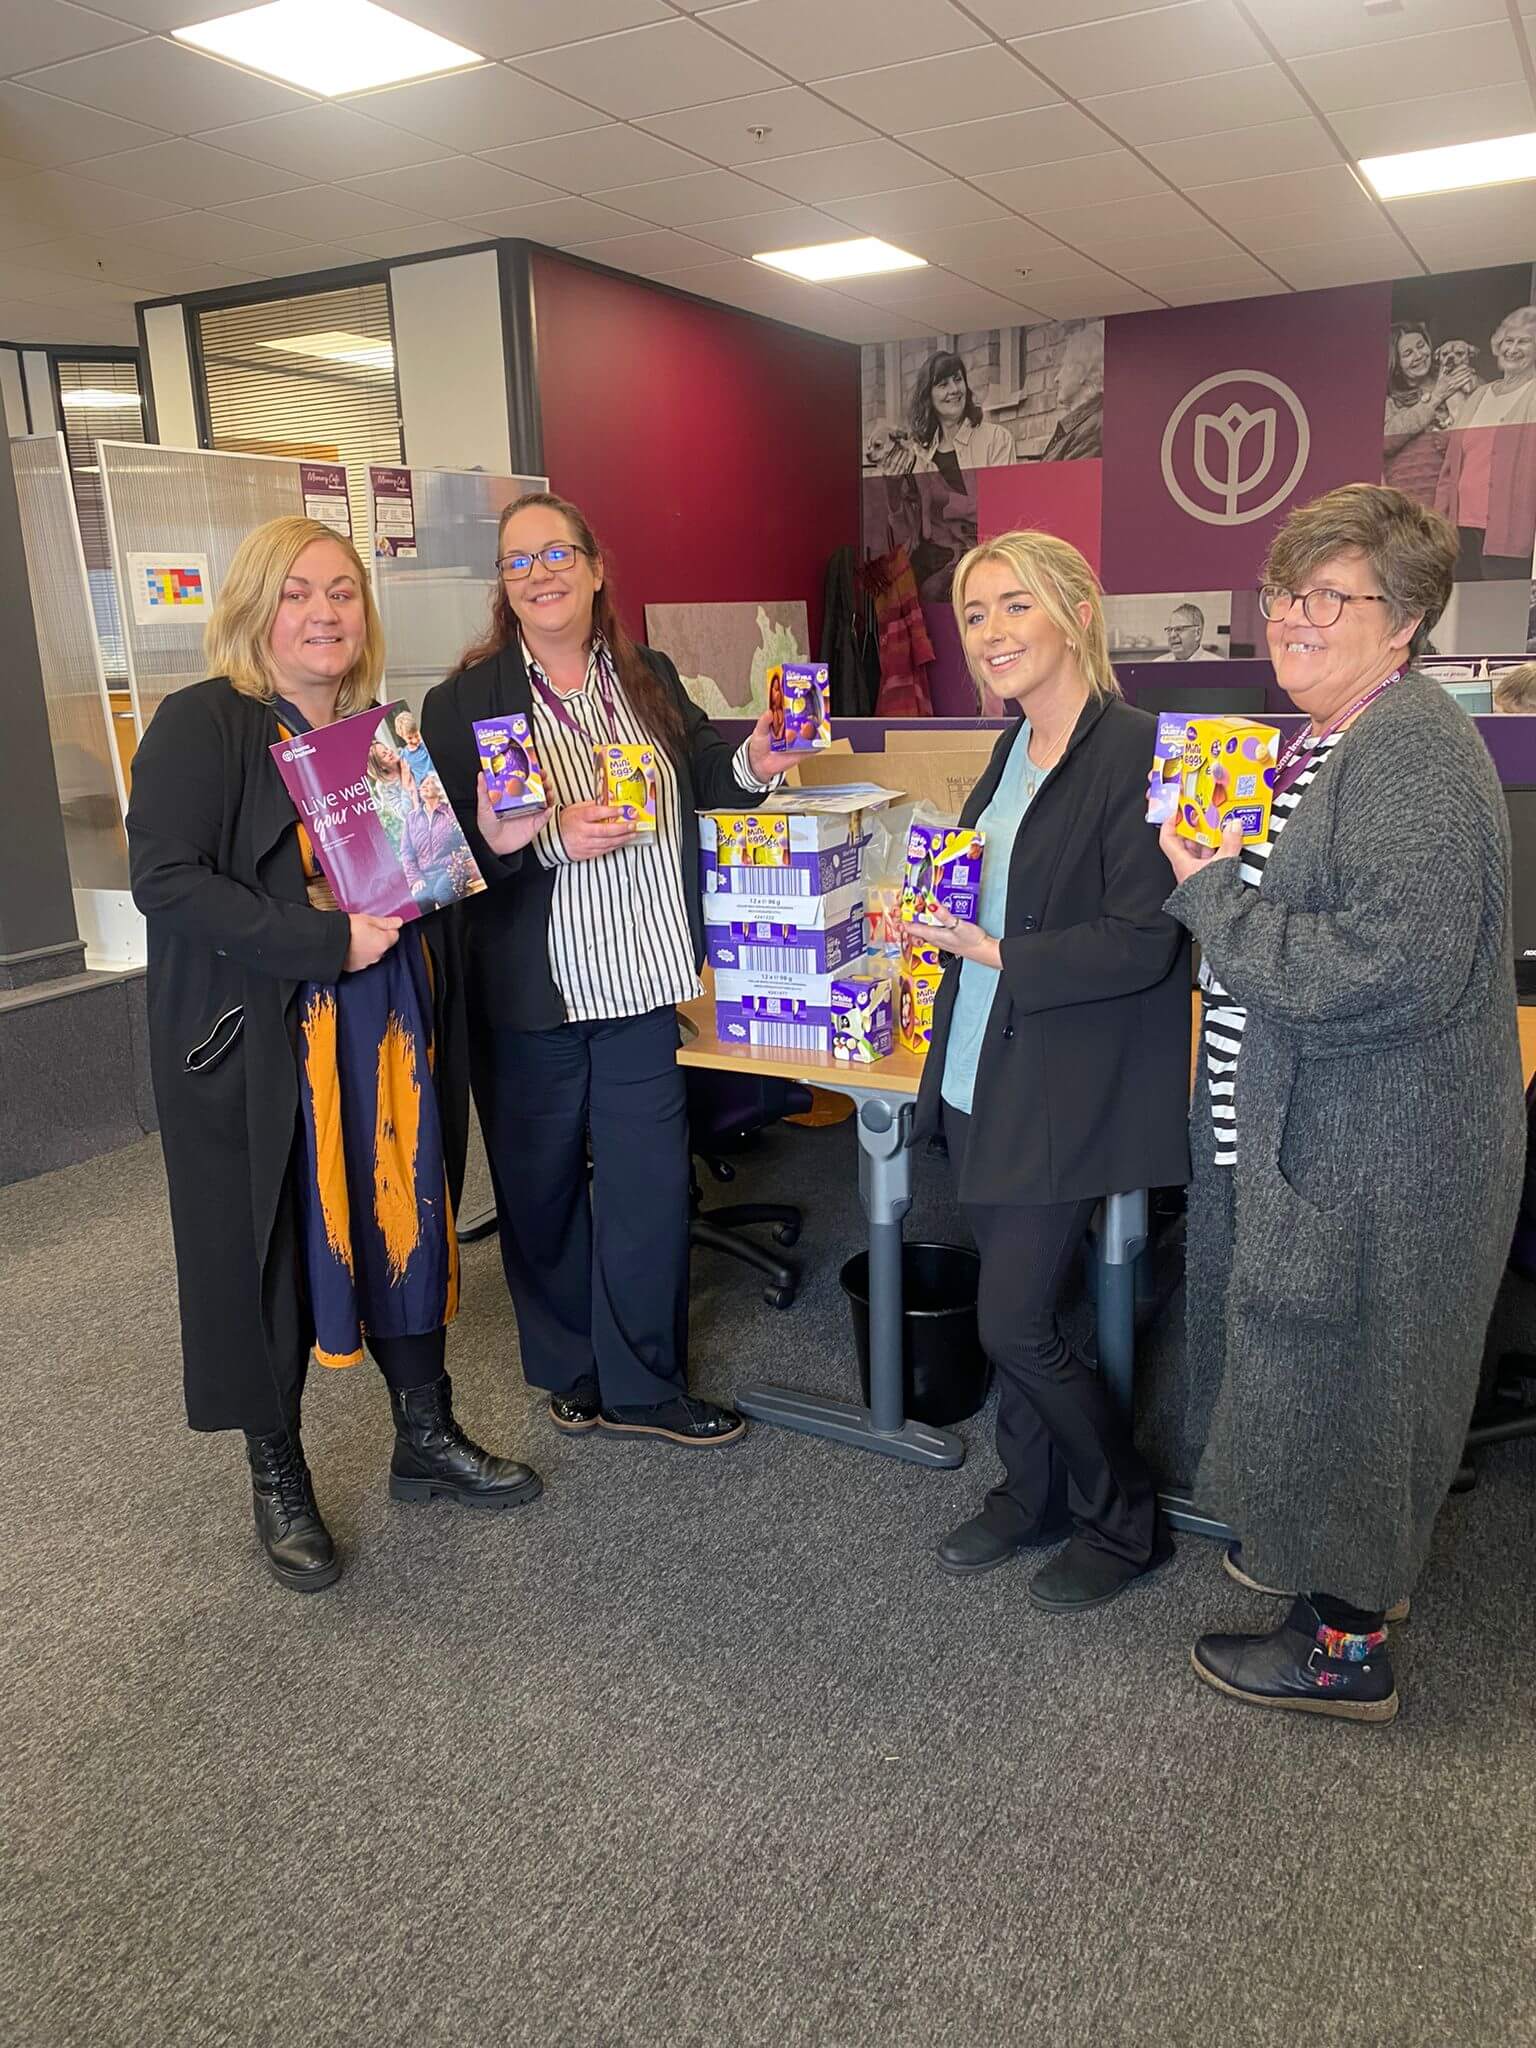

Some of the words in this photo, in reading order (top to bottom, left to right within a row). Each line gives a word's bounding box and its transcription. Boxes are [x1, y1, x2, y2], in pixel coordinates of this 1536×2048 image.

[1185, 742, 1202, 754] Mini
[610, 757, 630, 770] Mini
[1184, 754, 1203, 767] eggs
[610, 767, 633, 777] eggs
[301, 793, 339, 815] Live
[339, 775, 370, 801] well
[314, 807, 348, 841] your
[747, 826, 765, 836] Mini
[747, 834, 767, 843] eggs
